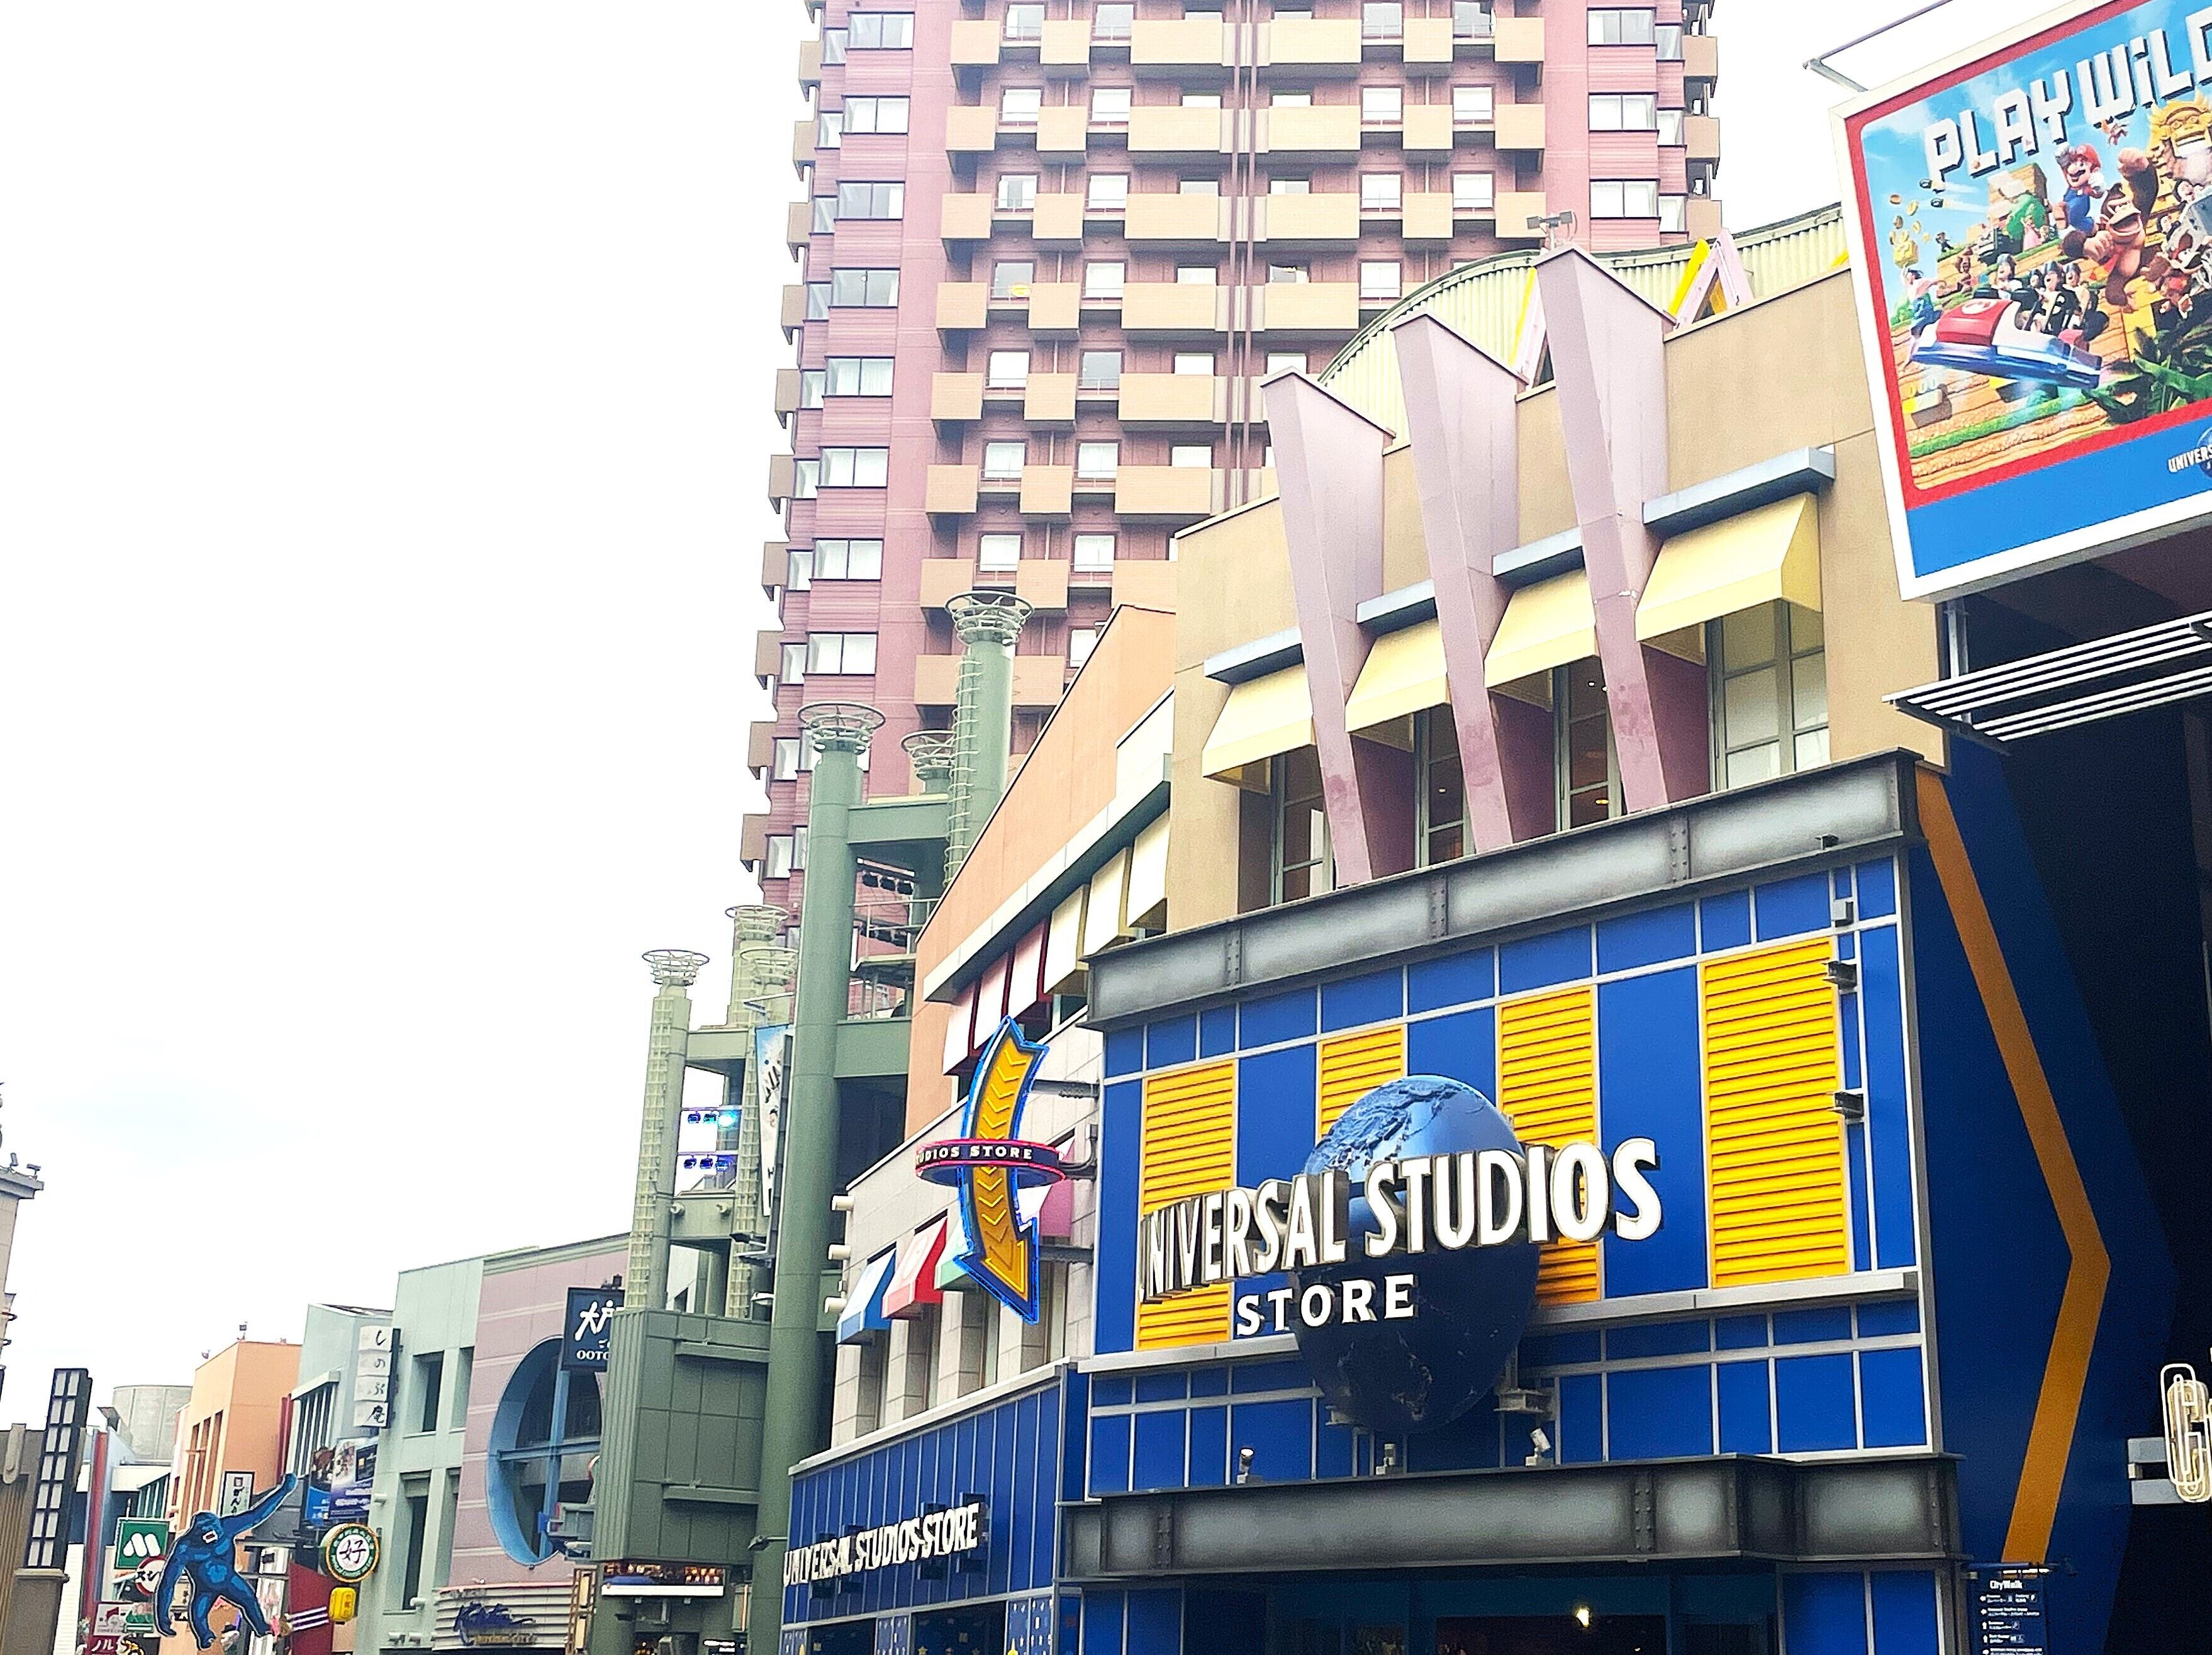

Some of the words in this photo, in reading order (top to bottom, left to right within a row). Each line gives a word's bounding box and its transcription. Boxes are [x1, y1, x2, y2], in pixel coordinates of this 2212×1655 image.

[1924, 69, 2074, 193] PLAY
[970, 1145, 1032, 1160] STORE
[1139, 1169, 1349, 1304] NIVERSAL
[1364, 1137, 1662, 1257] STUDIOS
[1236, 1273, 1417, 1337] STORE
[783, 1536, 852, 1587] UNIVERSAL
[854, 1517, 922, 1573] STUDIOS
[922, 1502, 980, 1559] STORE
